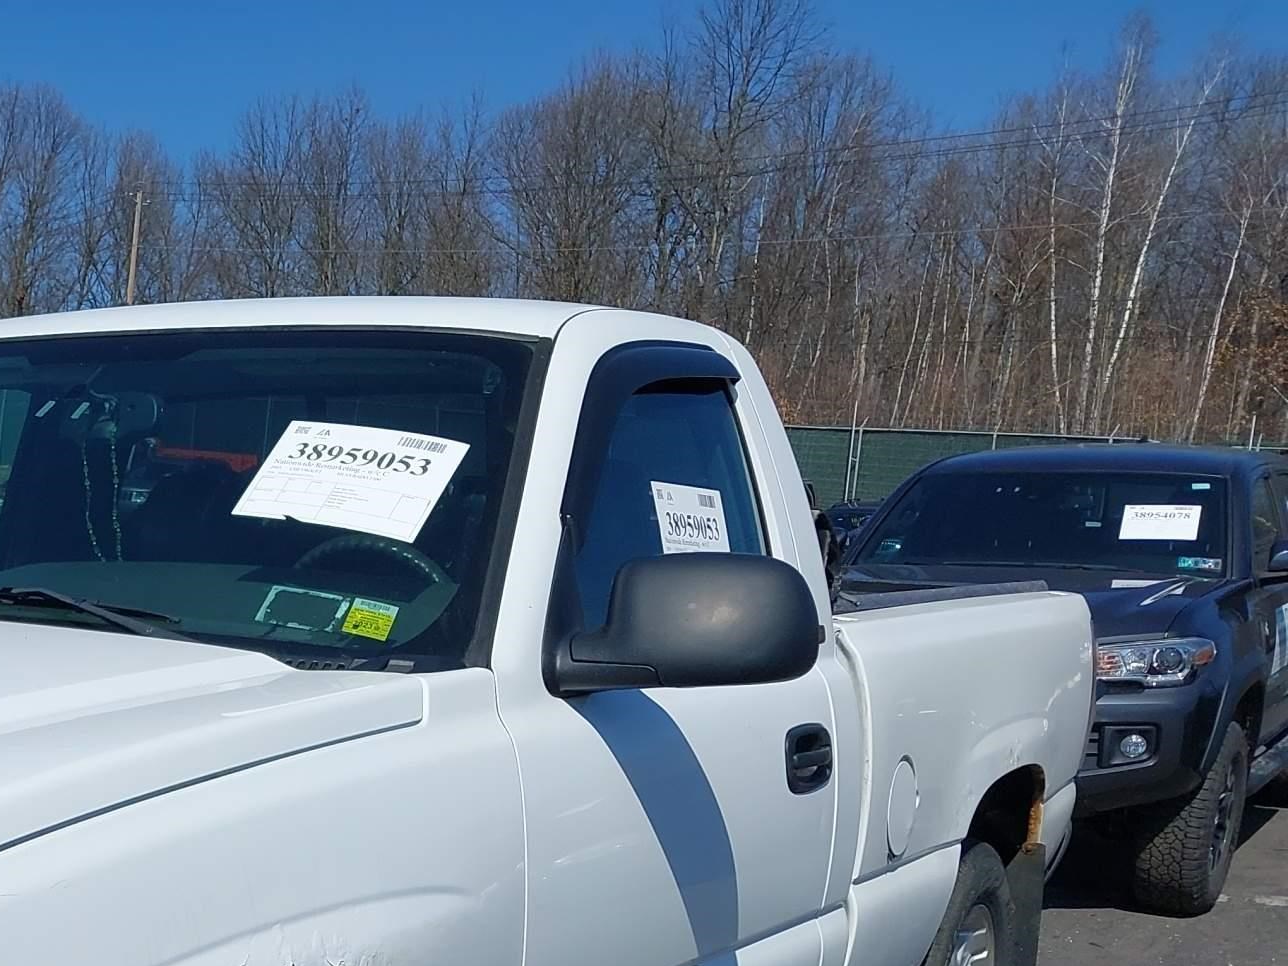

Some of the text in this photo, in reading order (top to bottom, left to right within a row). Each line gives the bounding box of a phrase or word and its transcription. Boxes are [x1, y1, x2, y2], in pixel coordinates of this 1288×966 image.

[288, 442, 432, 477] 38959053
[666, 511, 720, 541] 38959053
[1134, 511, 1191, 519] 38954078
